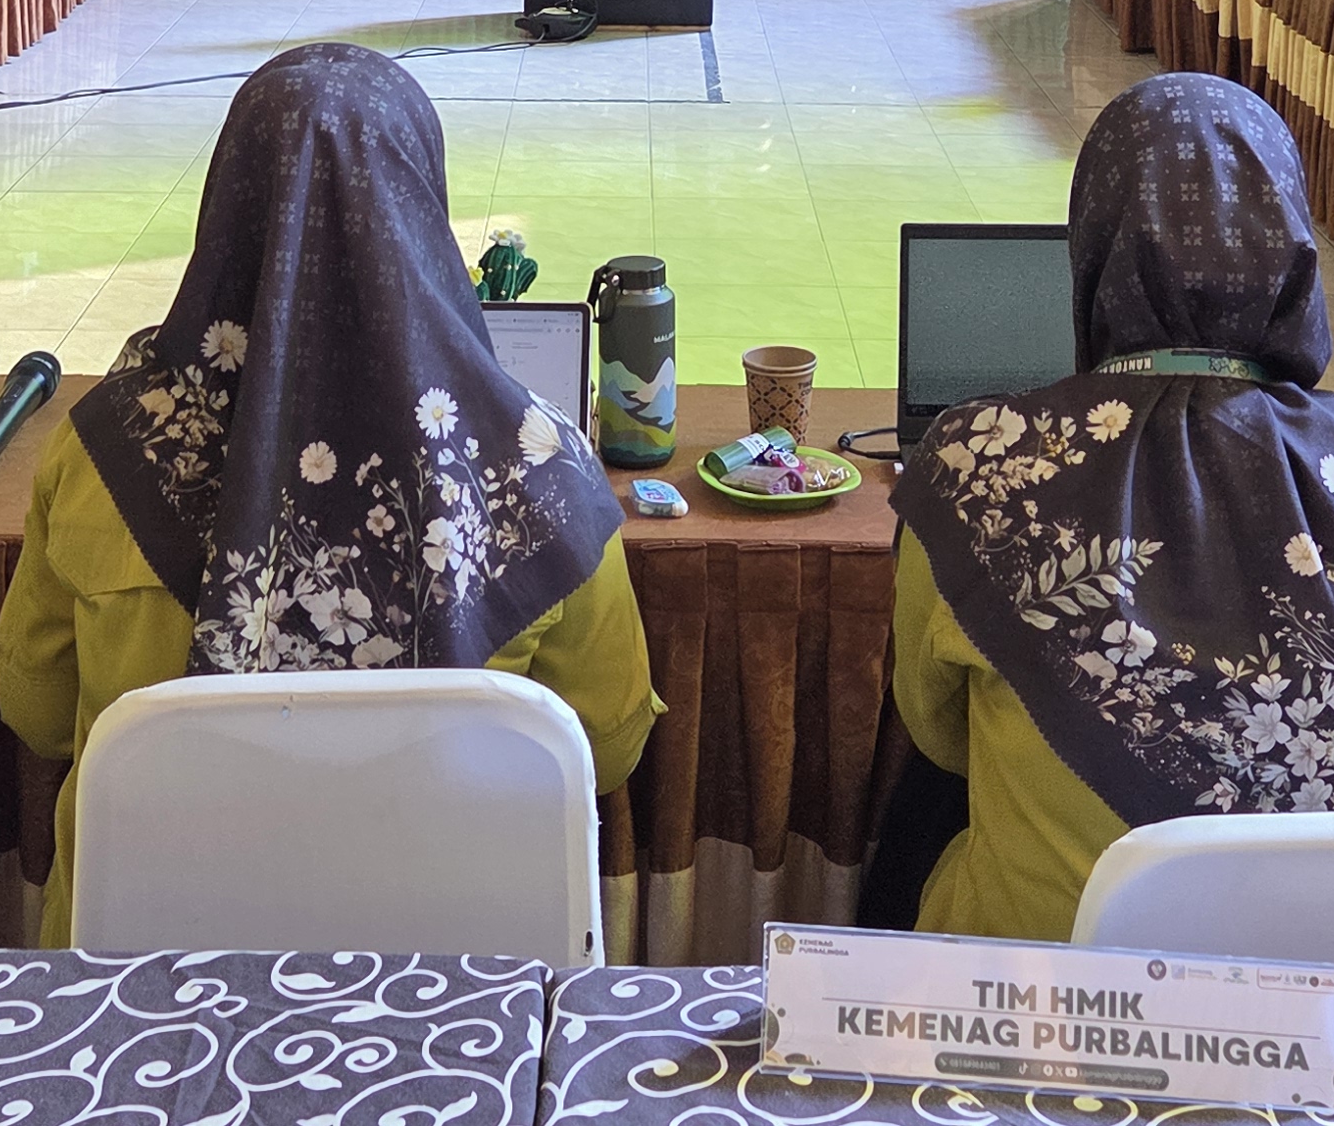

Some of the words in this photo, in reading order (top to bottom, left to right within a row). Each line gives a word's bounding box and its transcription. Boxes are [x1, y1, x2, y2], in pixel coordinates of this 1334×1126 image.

[971, 978, 1037, 1013] TIM
[1050, 986, 1145, 1021] HMIK
[836, 1004, 1021, 1049] KEMENAG
[1032, 1019, 1311, 1072] PURBALINGGA
